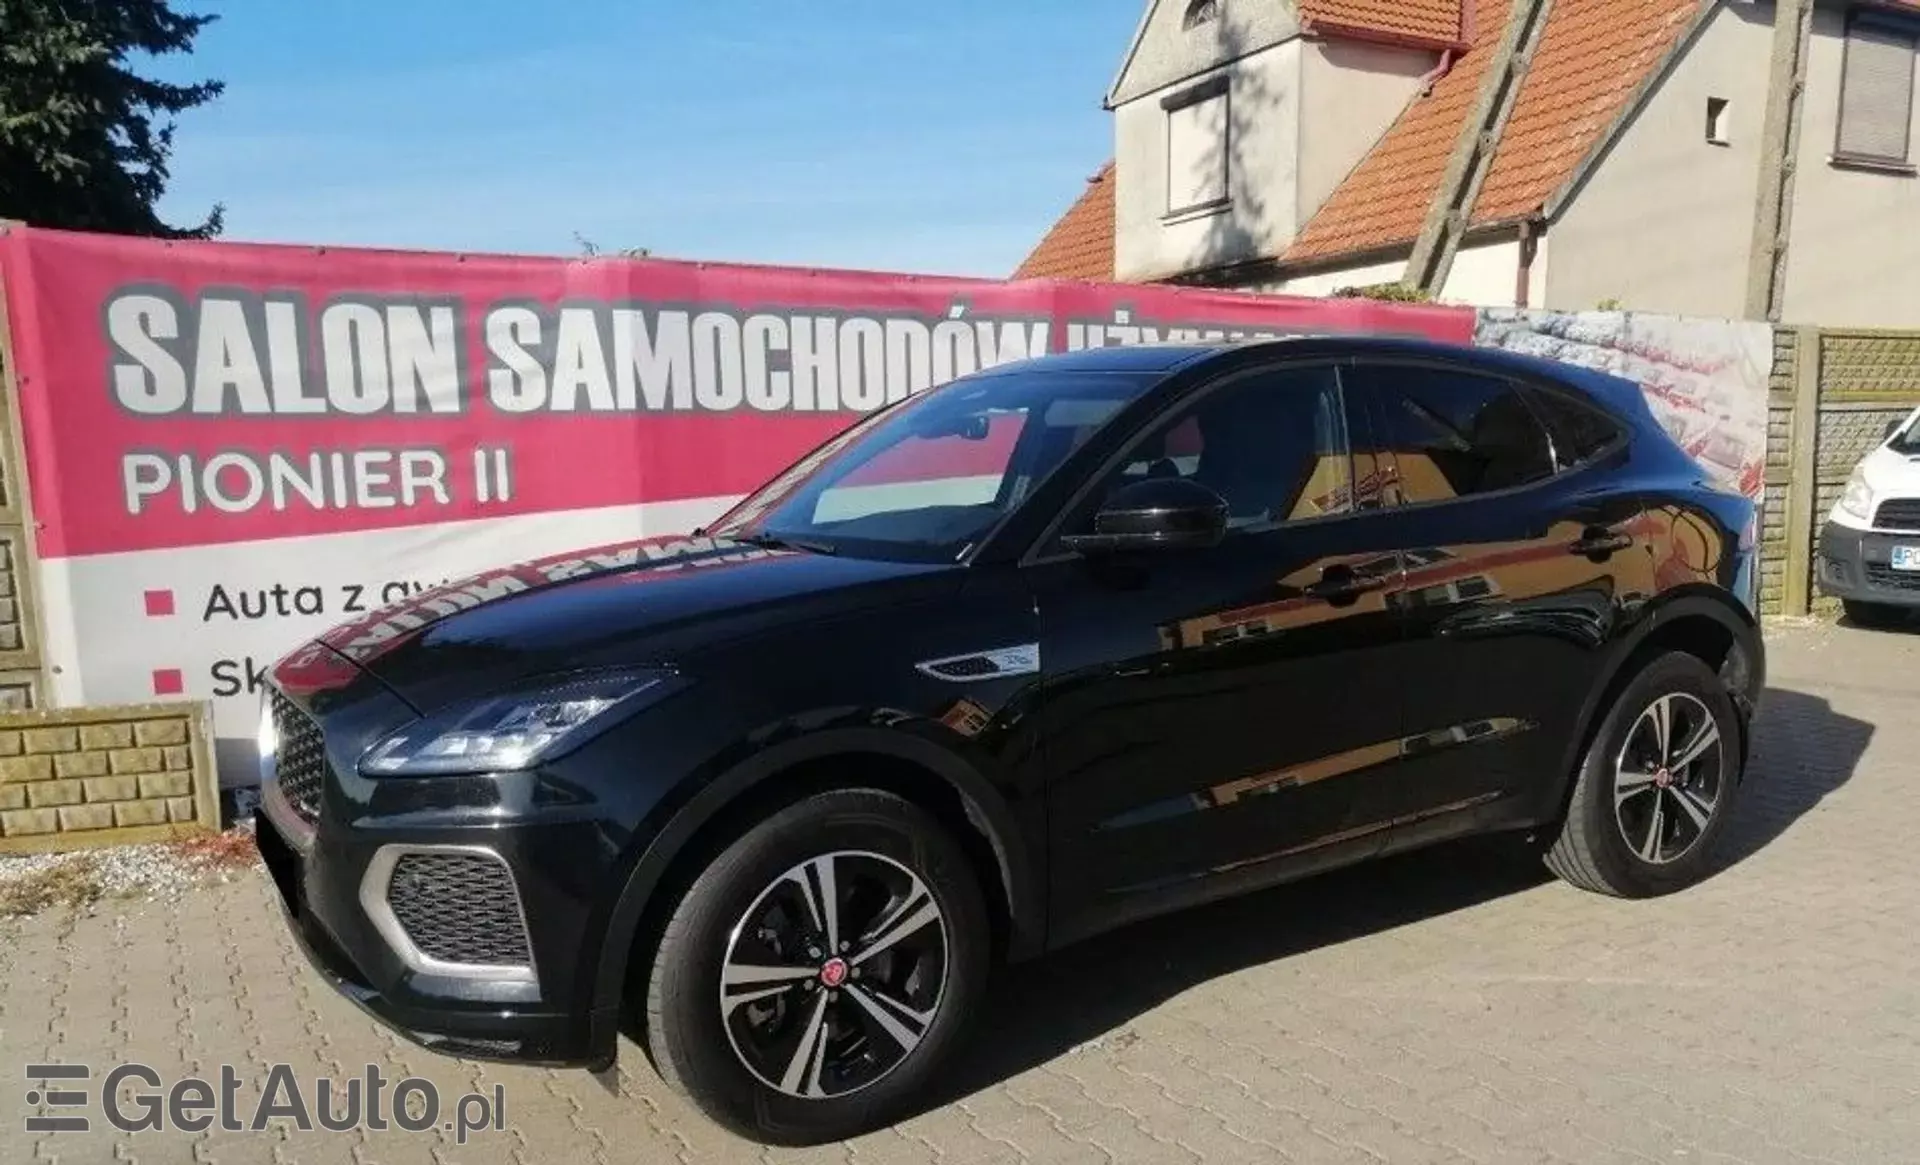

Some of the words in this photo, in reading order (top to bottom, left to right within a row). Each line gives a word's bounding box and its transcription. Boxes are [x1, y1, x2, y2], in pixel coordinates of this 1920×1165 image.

[108, 294, 461, 414] SALON
[123, 449, 449, 514] PIONIER
[474, 448, 512, 502] II
[203, 584, 324, 621] Auta
[342, 585, 366, 612] z
